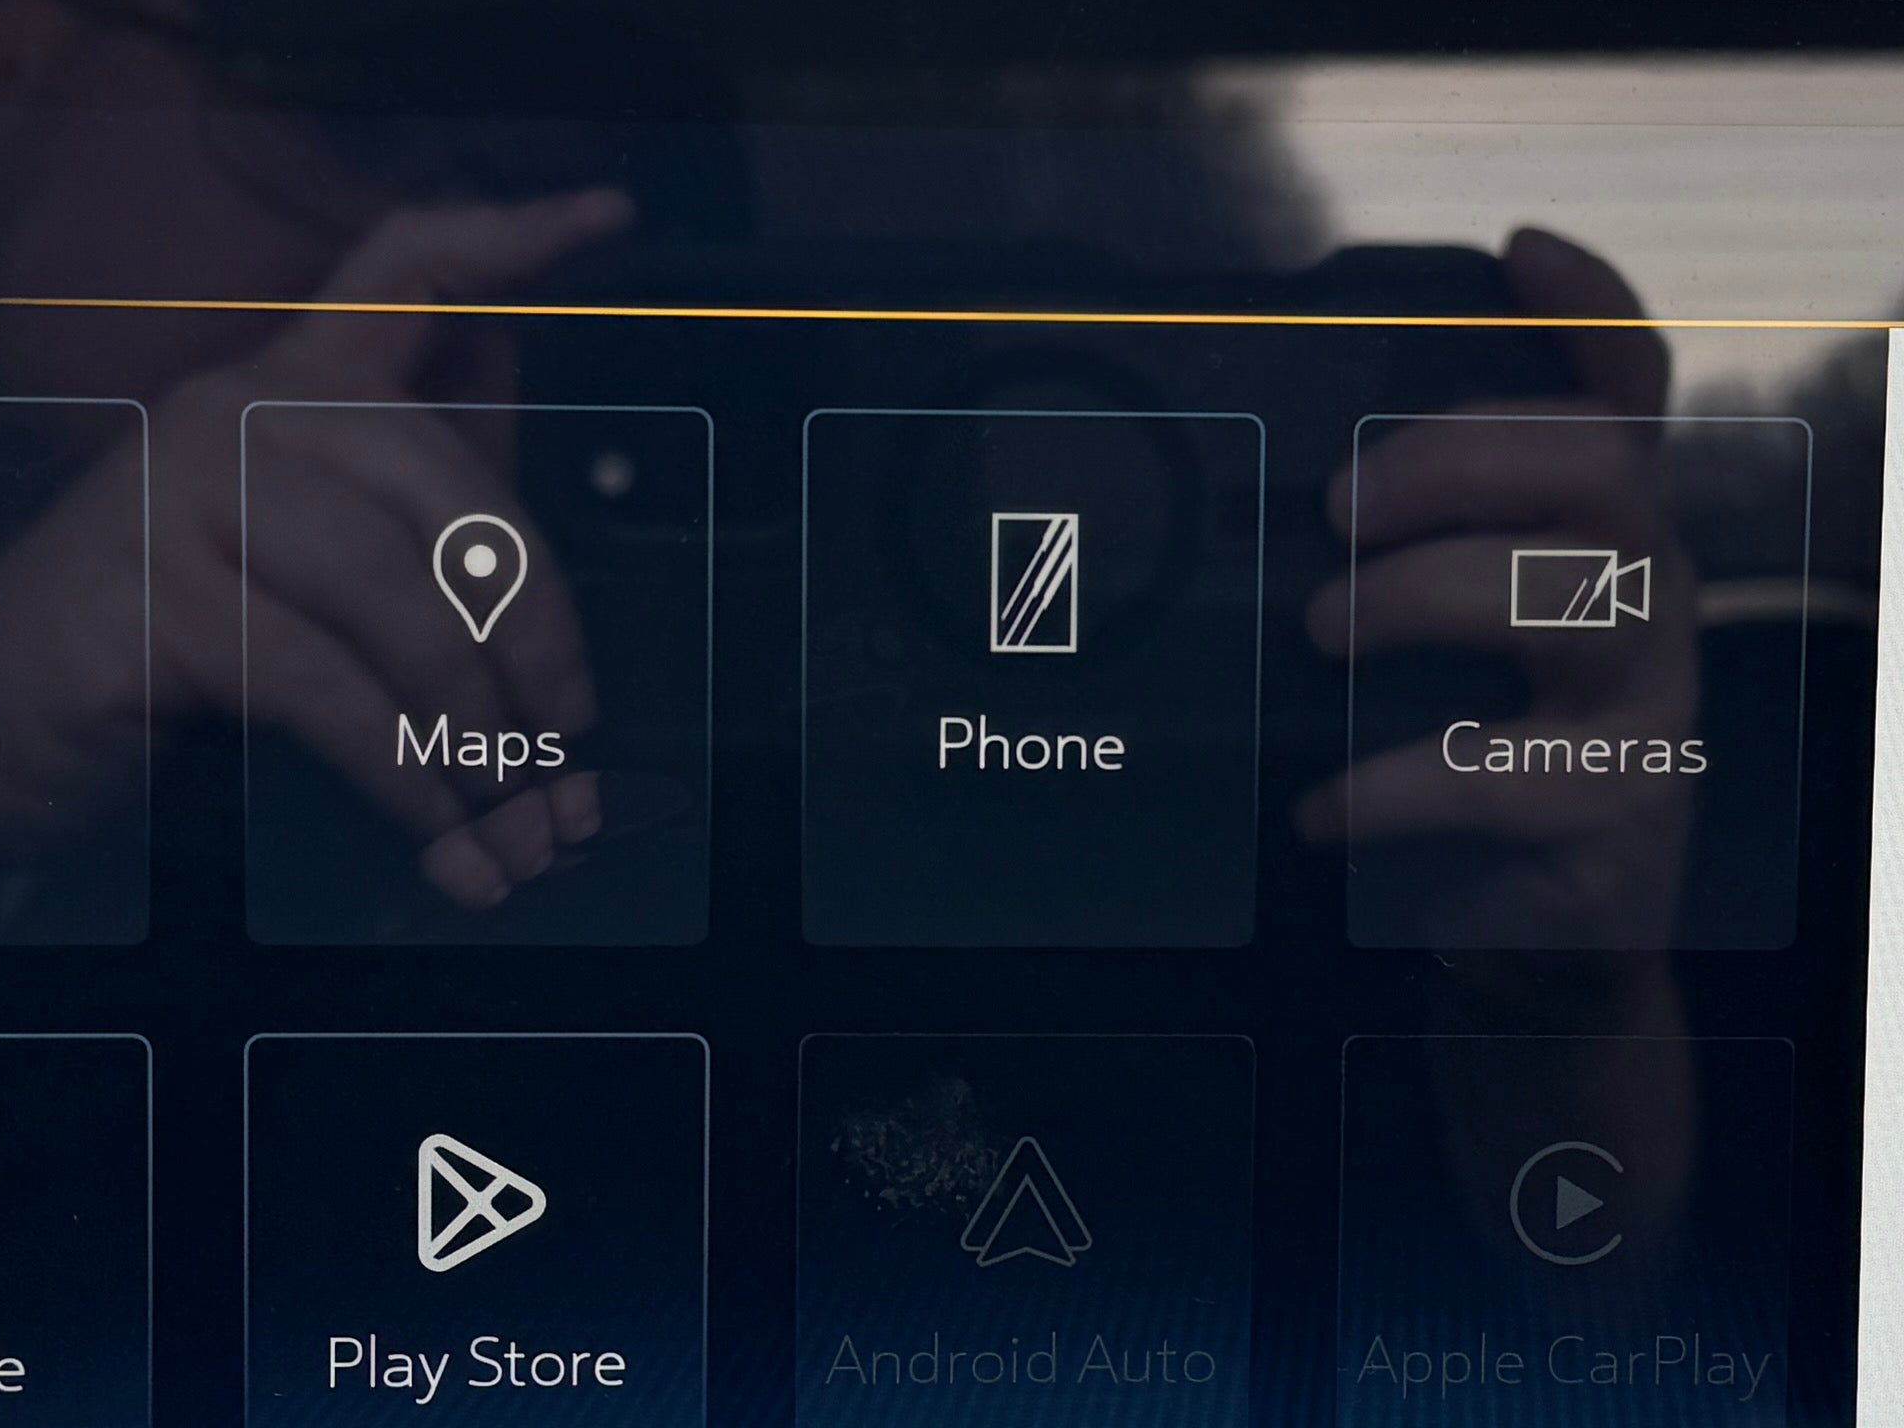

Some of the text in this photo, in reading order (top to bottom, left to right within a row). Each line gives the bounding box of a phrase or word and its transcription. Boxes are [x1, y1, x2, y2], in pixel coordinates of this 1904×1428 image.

[395, 714, 567, 782] Maps
[937, 714, 1126, 771] Phone
[1440, 720, 1709, 774] Cameras
[326, 1334, 627, 1404] Play Store
[824, 1332, 1217, 1386] Android Auto
[1356, 1333, 1772, 1402] Apple CarPlay
